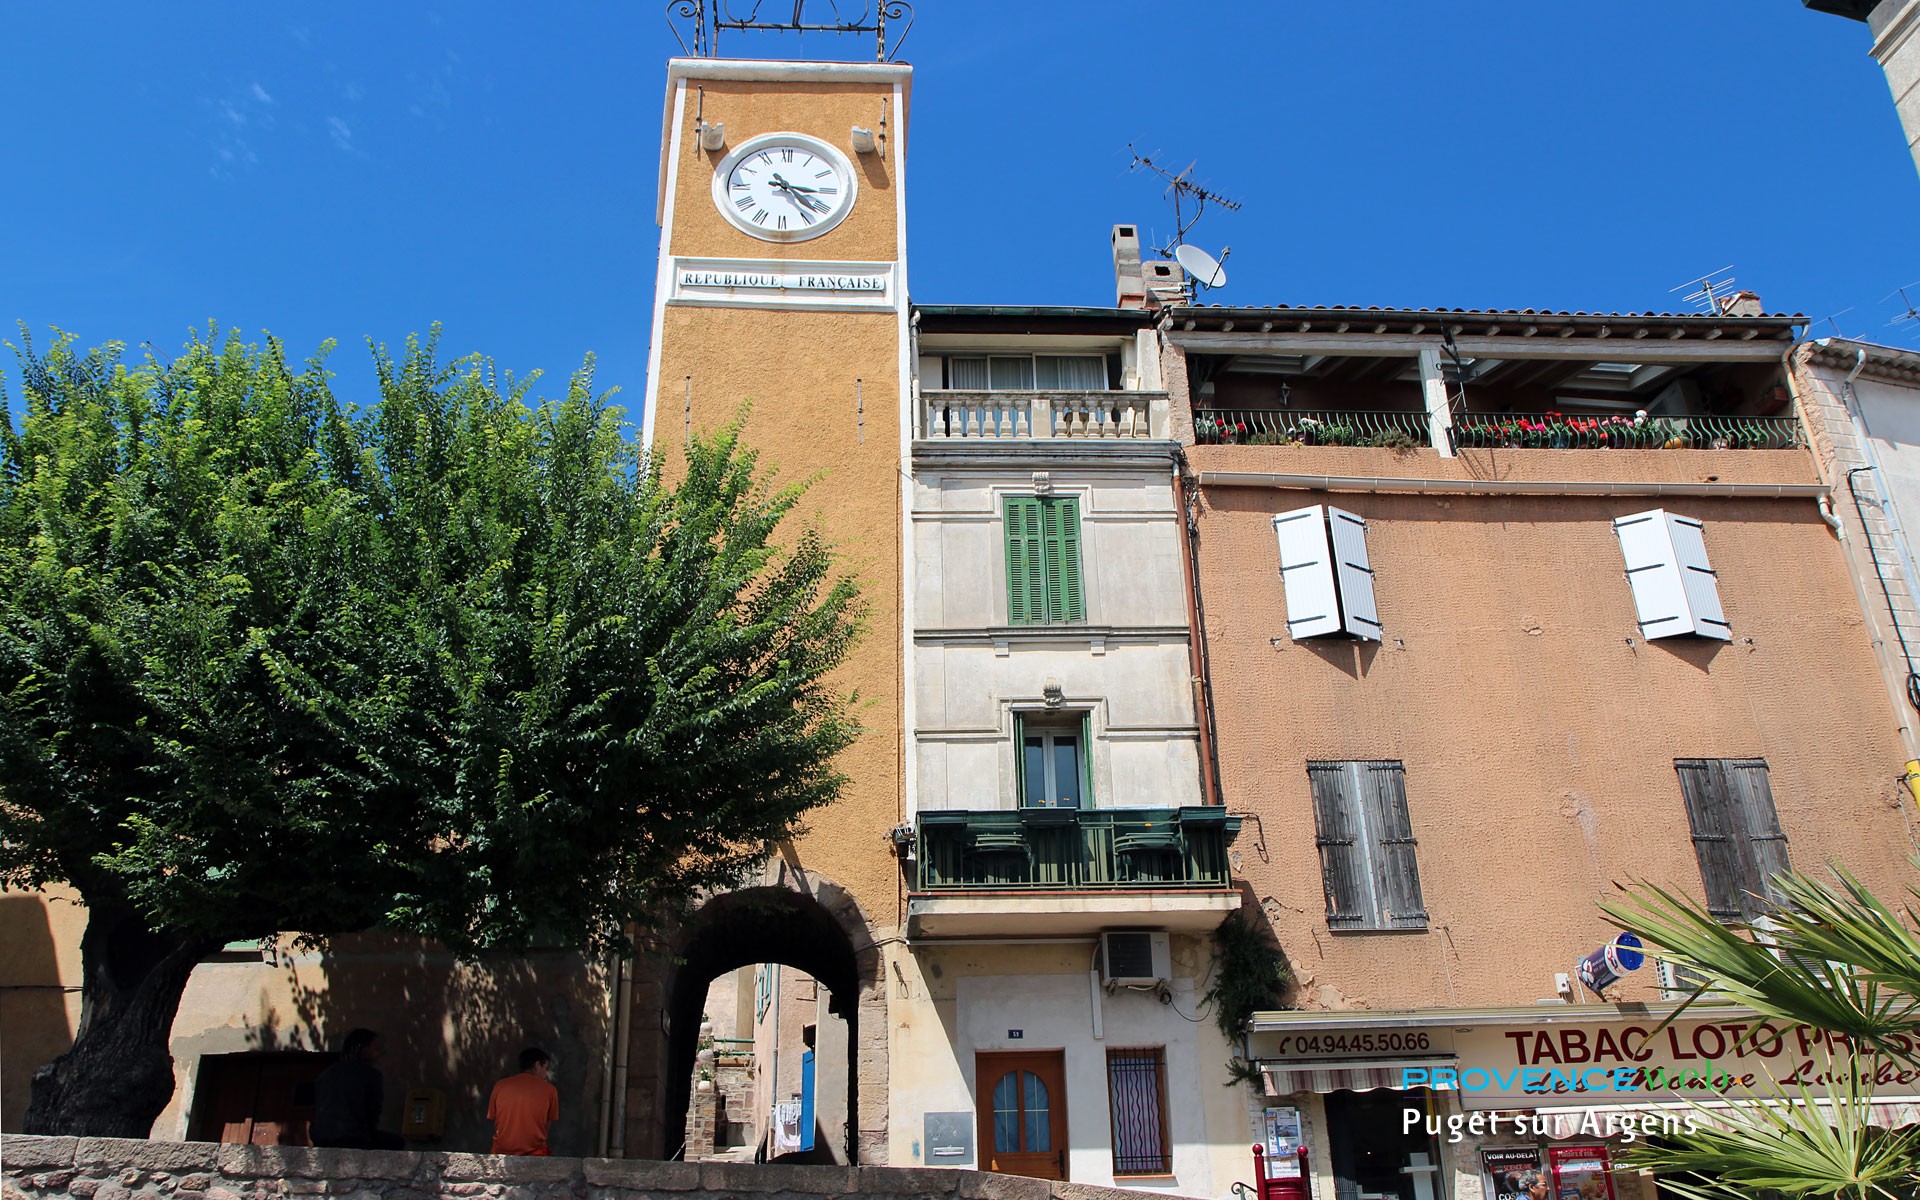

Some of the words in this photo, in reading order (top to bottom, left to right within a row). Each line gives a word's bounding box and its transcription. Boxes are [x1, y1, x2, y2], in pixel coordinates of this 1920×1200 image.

[781, 149, 793, 163] XII
[799, 275, 882, 290] FRANÇAISE
[1295, 1032, 1430, 1054] 04.94.45.50.66
[1505, 1026, 1653, 1066] TABAC
[1666, 1024, 1783, 1060] LOTO
